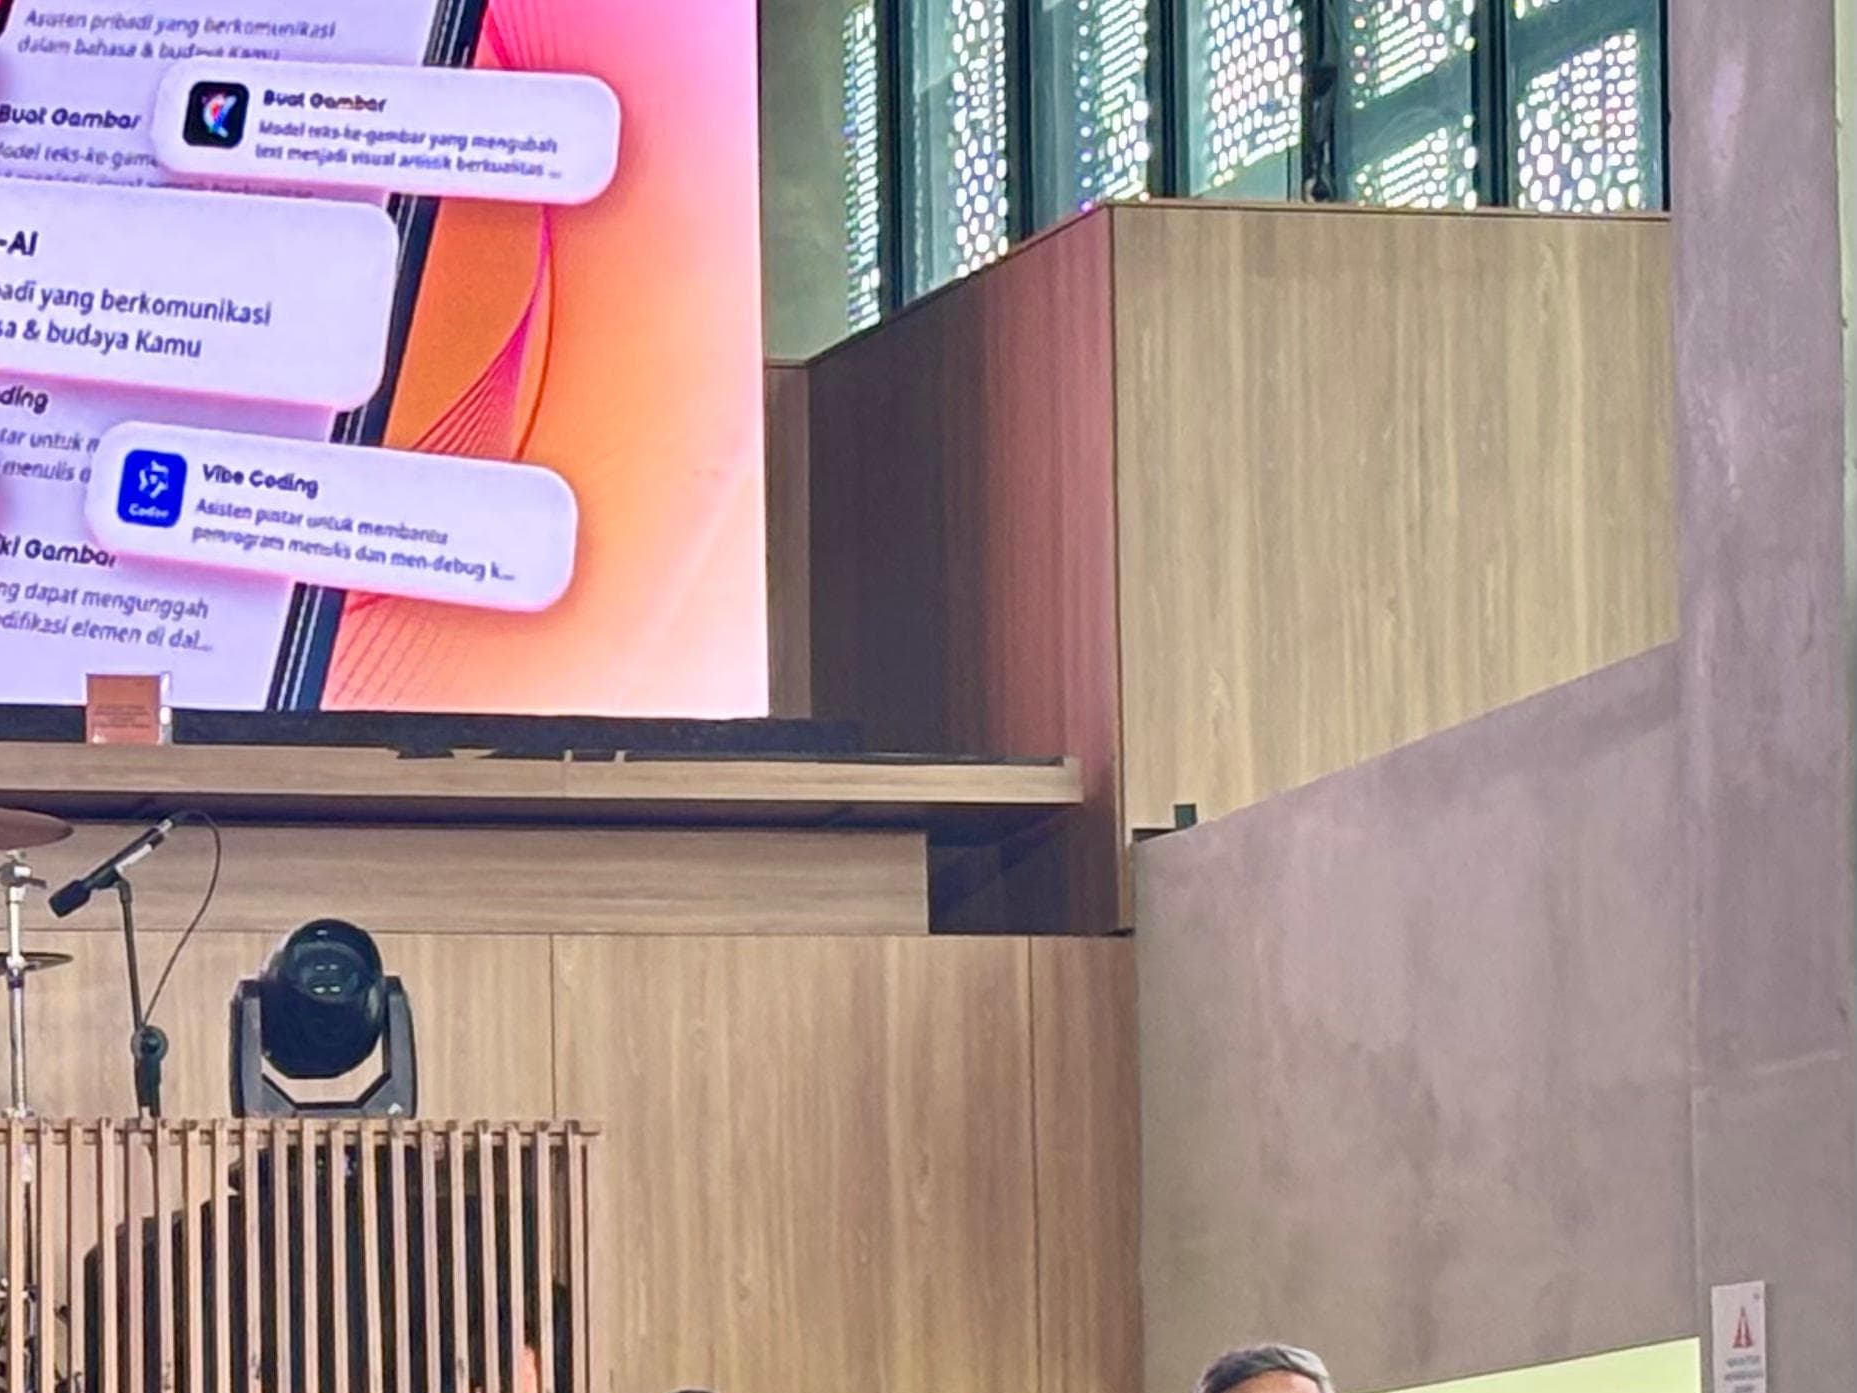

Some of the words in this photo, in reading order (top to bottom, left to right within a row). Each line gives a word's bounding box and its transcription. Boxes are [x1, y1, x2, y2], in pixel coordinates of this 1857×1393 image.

[154, 16, 199, 38] yang
[203, 17, 337, 40] berkomunikasi
[263, 89, 305, 108] Buat
[51, 106, 141, 130] Gambar
[258, 120, 305, 137] Model
[429, 132, 468, 152] yang
[471, 135, 559, 155] mengubah
[287, 147, 348, 167] menjadi
[351, 151, 396, 167] visual
[37, 286, 95, 316] yang
[100, 287, 272, 327] berkomunikasi
[22, 319, 41, 341] &
[45, 319, 130, 355] budaya
[135, 329, 203, 359] Kamu
[29, 432, 82, 452] untuk
[2, 460, 75, 482] menulis
[202, 463, 245, 486] Vibe
[249, 469, 319, 500] Coding
[196, 497, 253, 520] Asisten
[306, 514, 354, 533] untuk
[357, 520, 449, 546] membantu
[24, 538, 116, 569] Gambar
[354, 544, 387, 565] dan
[389, 551, 486, 583] men-debug
[24, 581, 79, 607] dapat
[81, 588, 210, 622] mengunggah
[70, 617, 142, 645] elemen
[145, 625, 166, 647] di
